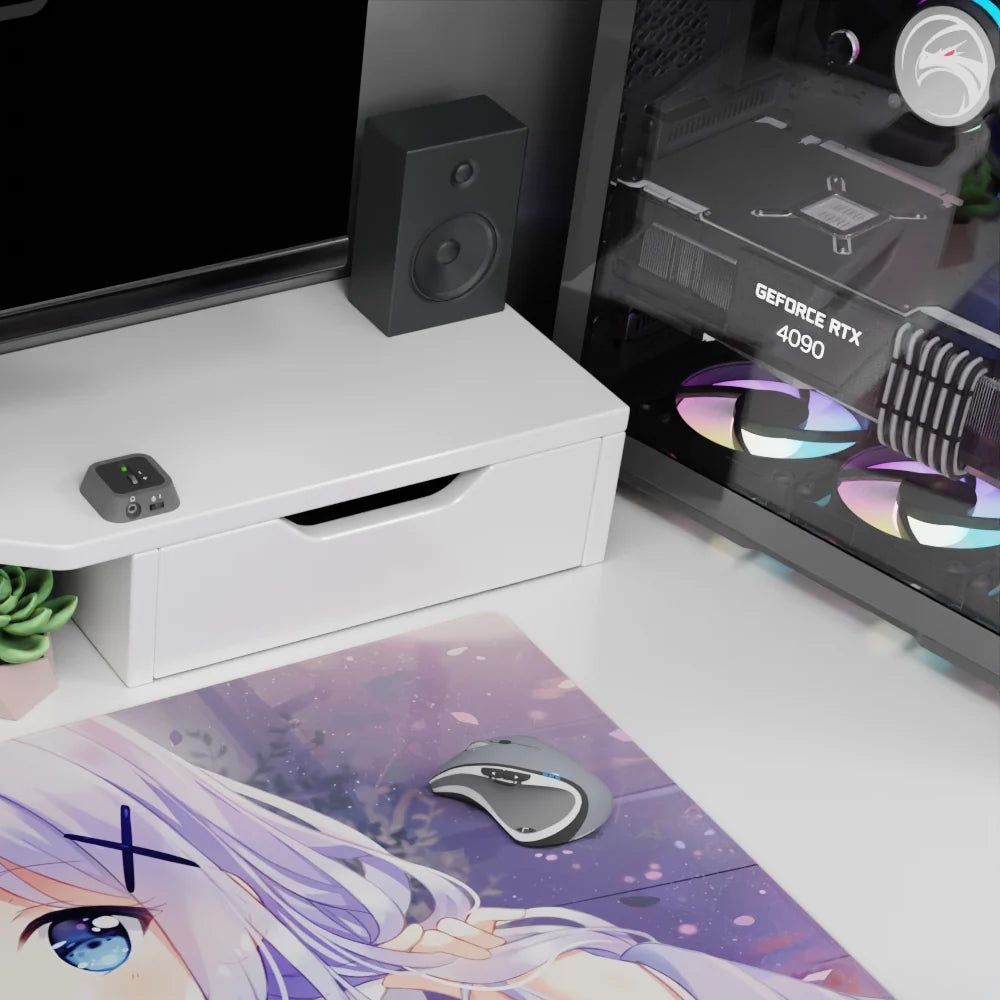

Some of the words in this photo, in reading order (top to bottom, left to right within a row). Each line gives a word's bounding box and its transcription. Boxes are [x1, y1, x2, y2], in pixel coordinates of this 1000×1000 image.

[755, 282, 827, 329] GEFORCE
[828, 318, 862, 346] RTX
[776, 325, 825, 360] 4090
